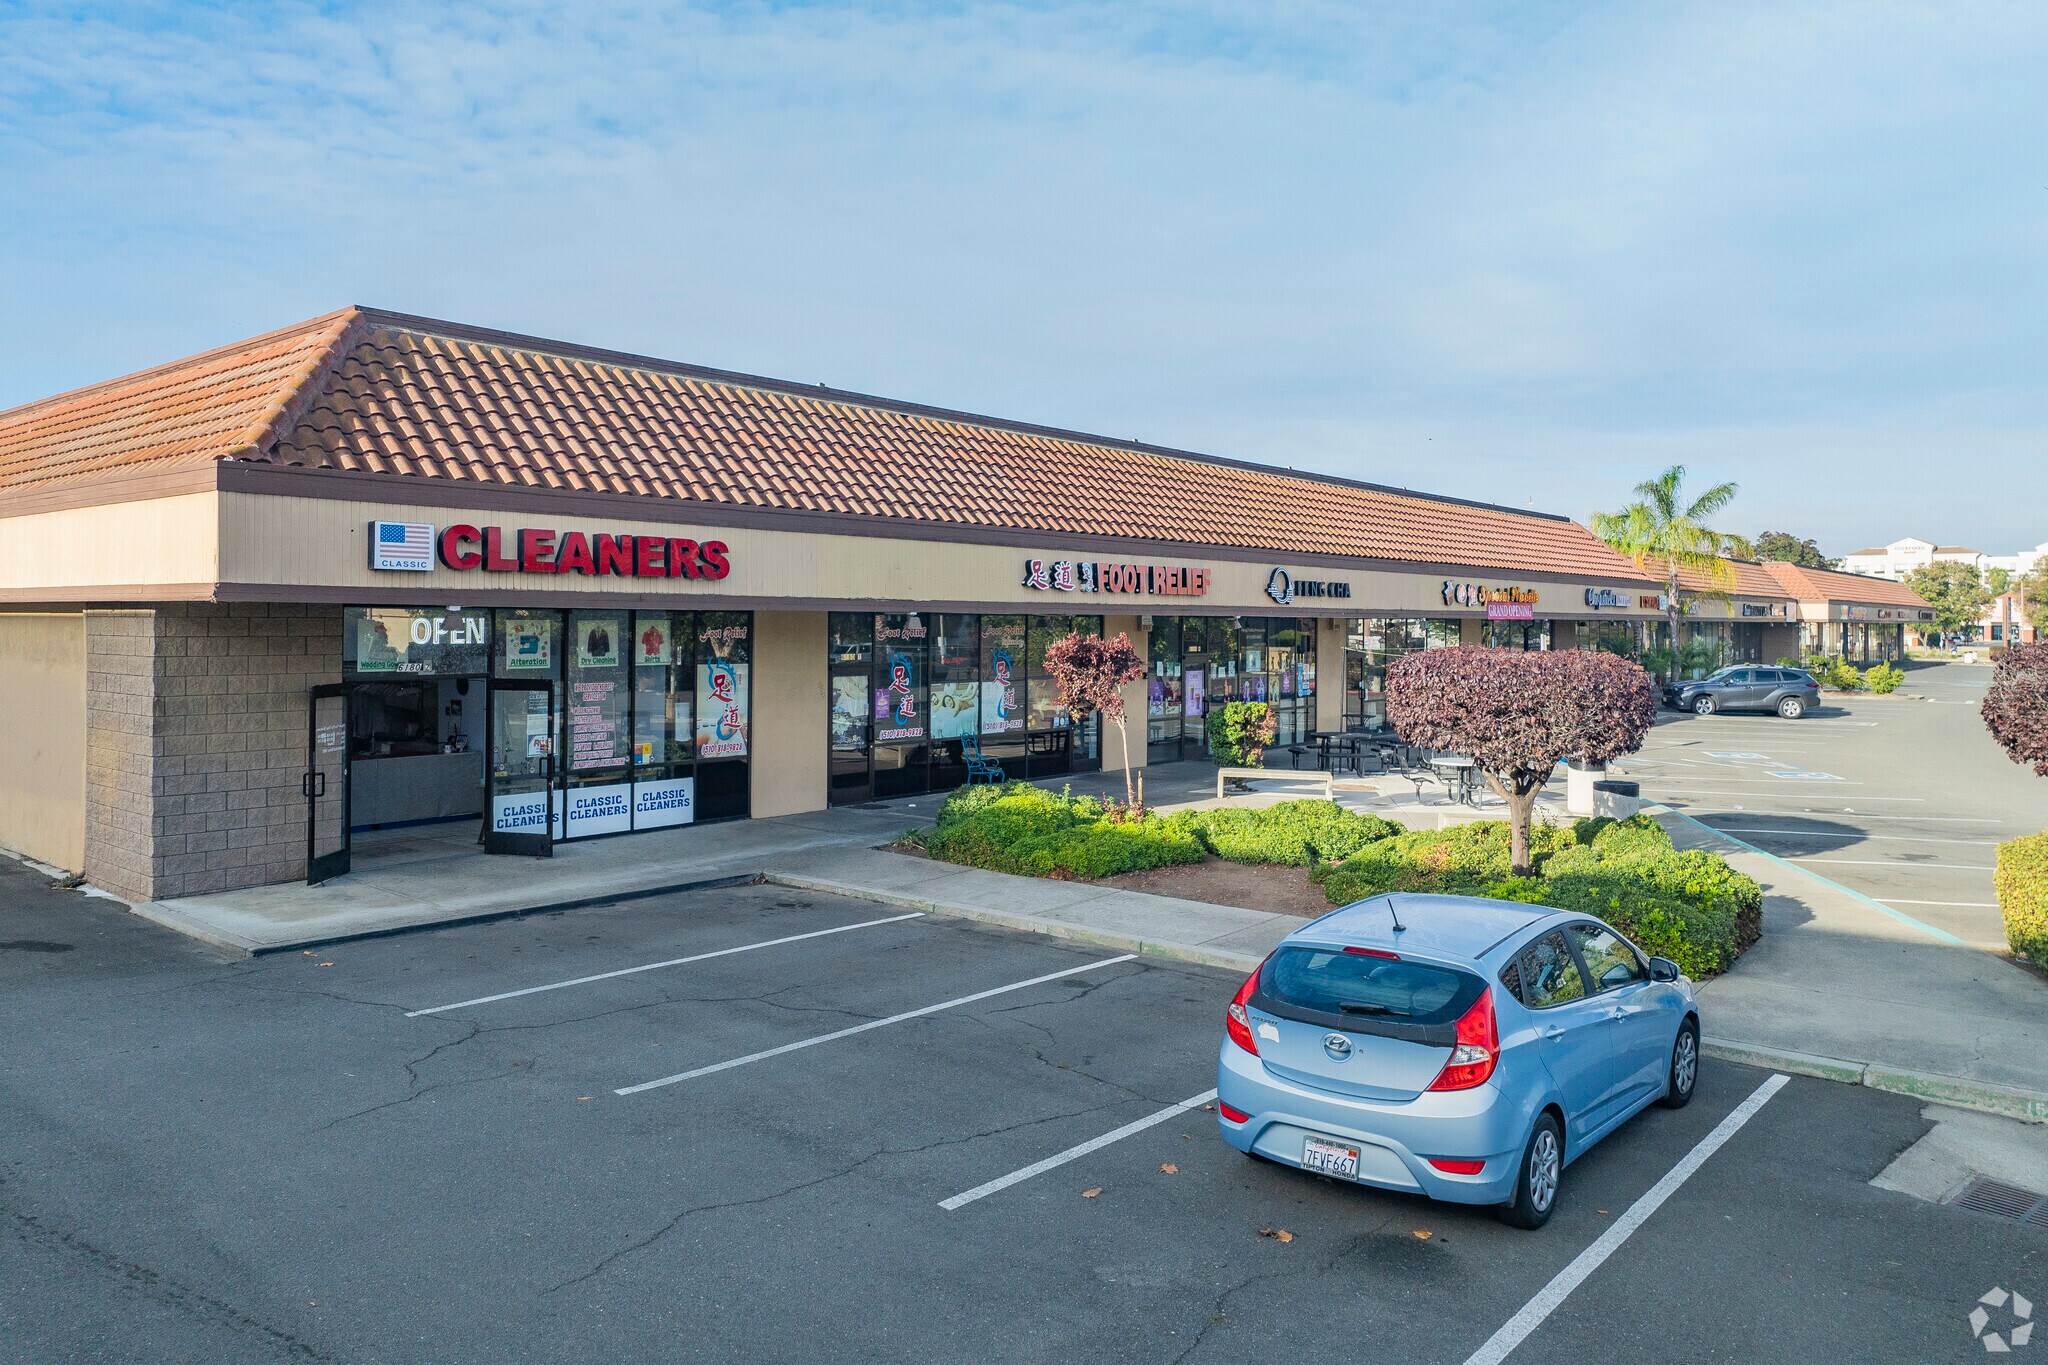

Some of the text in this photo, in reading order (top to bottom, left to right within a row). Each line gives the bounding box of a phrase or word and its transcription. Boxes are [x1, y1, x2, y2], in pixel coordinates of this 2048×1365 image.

[437, 524, 730, 581] CLEANERS
[381, 559, 427, 569] CLASSIC
[1095, 562, 1212, 595] FOOT RELIEF
[1327, 582, 1351, 598] CHA
[1488, 604, 1532, 617] GRAND OPENING
[411, 617, 486, 645] OPEN
[700, 626, 748, 642] Foot Relief
[877, 626, 927, 640] Foot Relief
[361, 661, 386, 669] Wedding
[510, 658, 548, 666] Alteration
[581, 655, 617, 666] Dry Cleaning
[644, 656, 661, 664] Shirts
[397, 663, 422, 672] 6180
[576, 795, 622, 809] CLASSIC
[642, 789, 685, 801] CLASSIC
[504, 803, 547, 817] CLASSI
[636, 798, 690, 812] CLEANERS
[570, 805, 628, 820] CLEANERS
[497, 813, 560, 829] CLEANES
[1303, 1162, 1356, 1180] TIPTON HONDA
